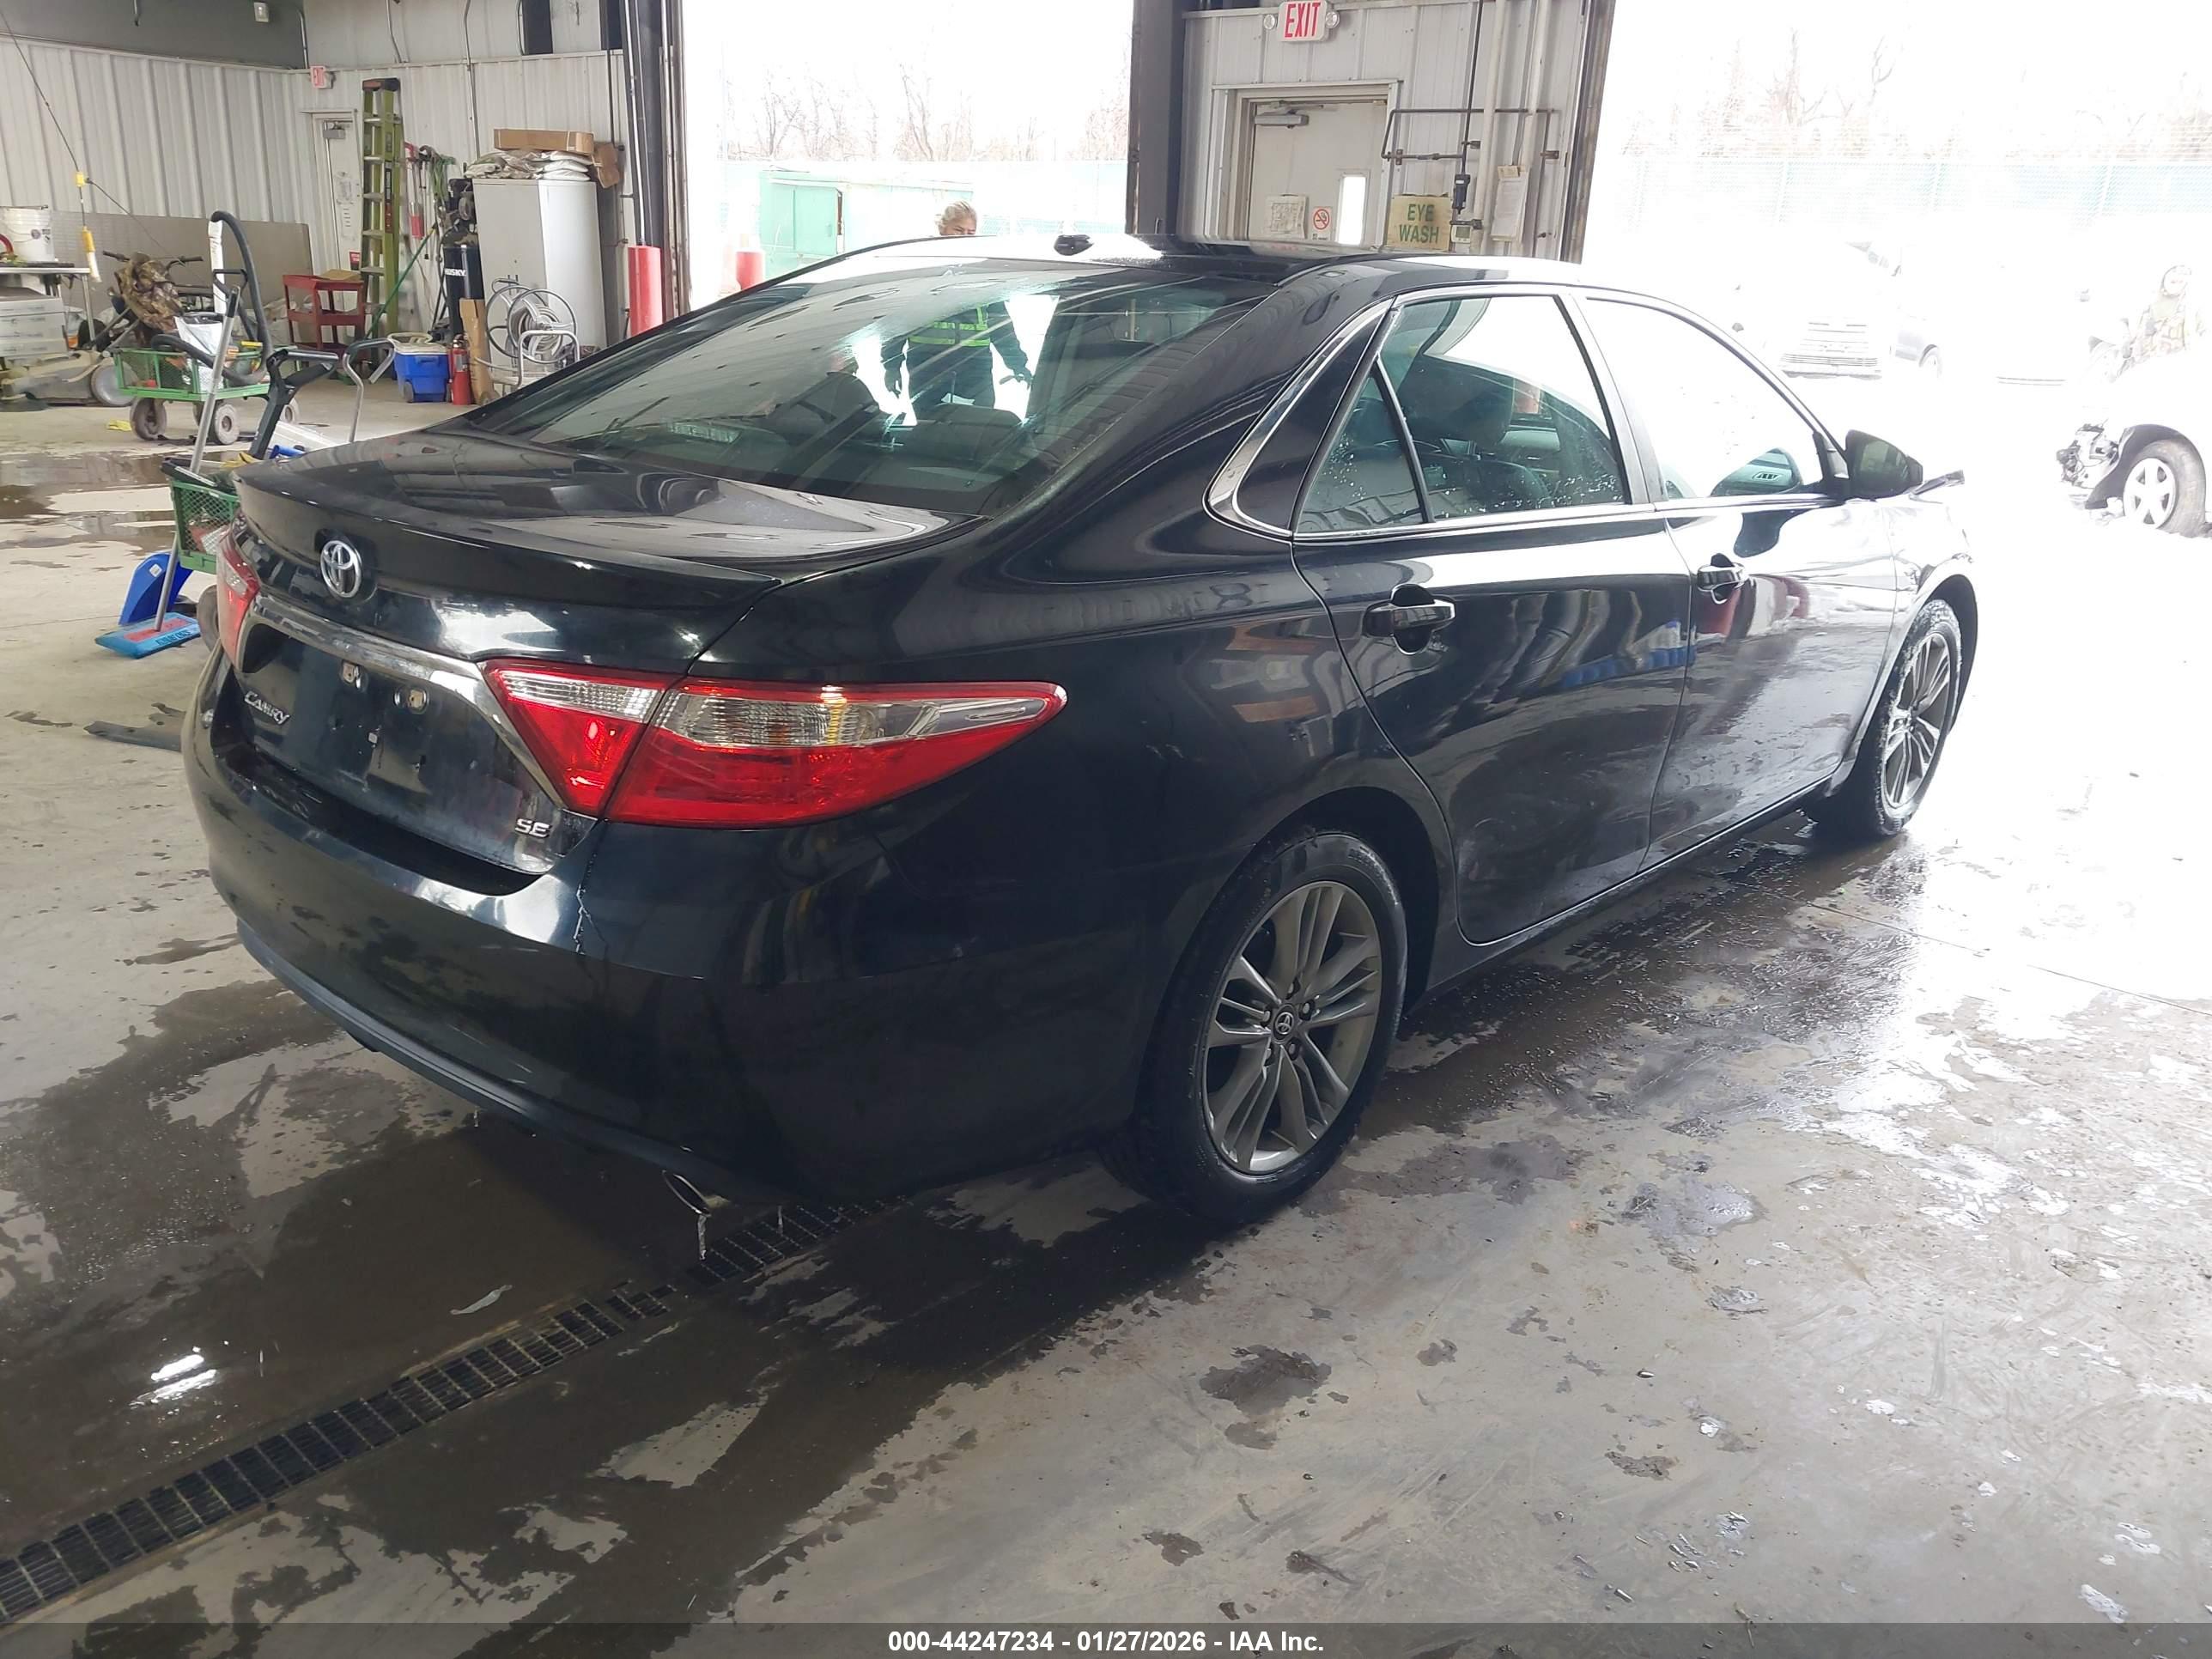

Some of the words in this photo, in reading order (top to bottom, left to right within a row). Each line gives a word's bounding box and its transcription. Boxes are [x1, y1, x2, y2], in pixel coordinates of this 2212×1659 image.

[1285, 2, 1321, 38] EXIT
[1407, 204, 1435, 222] EYE
[1399, 224, 1439, 244] WASH
[514, 818, 550, 838] SE
